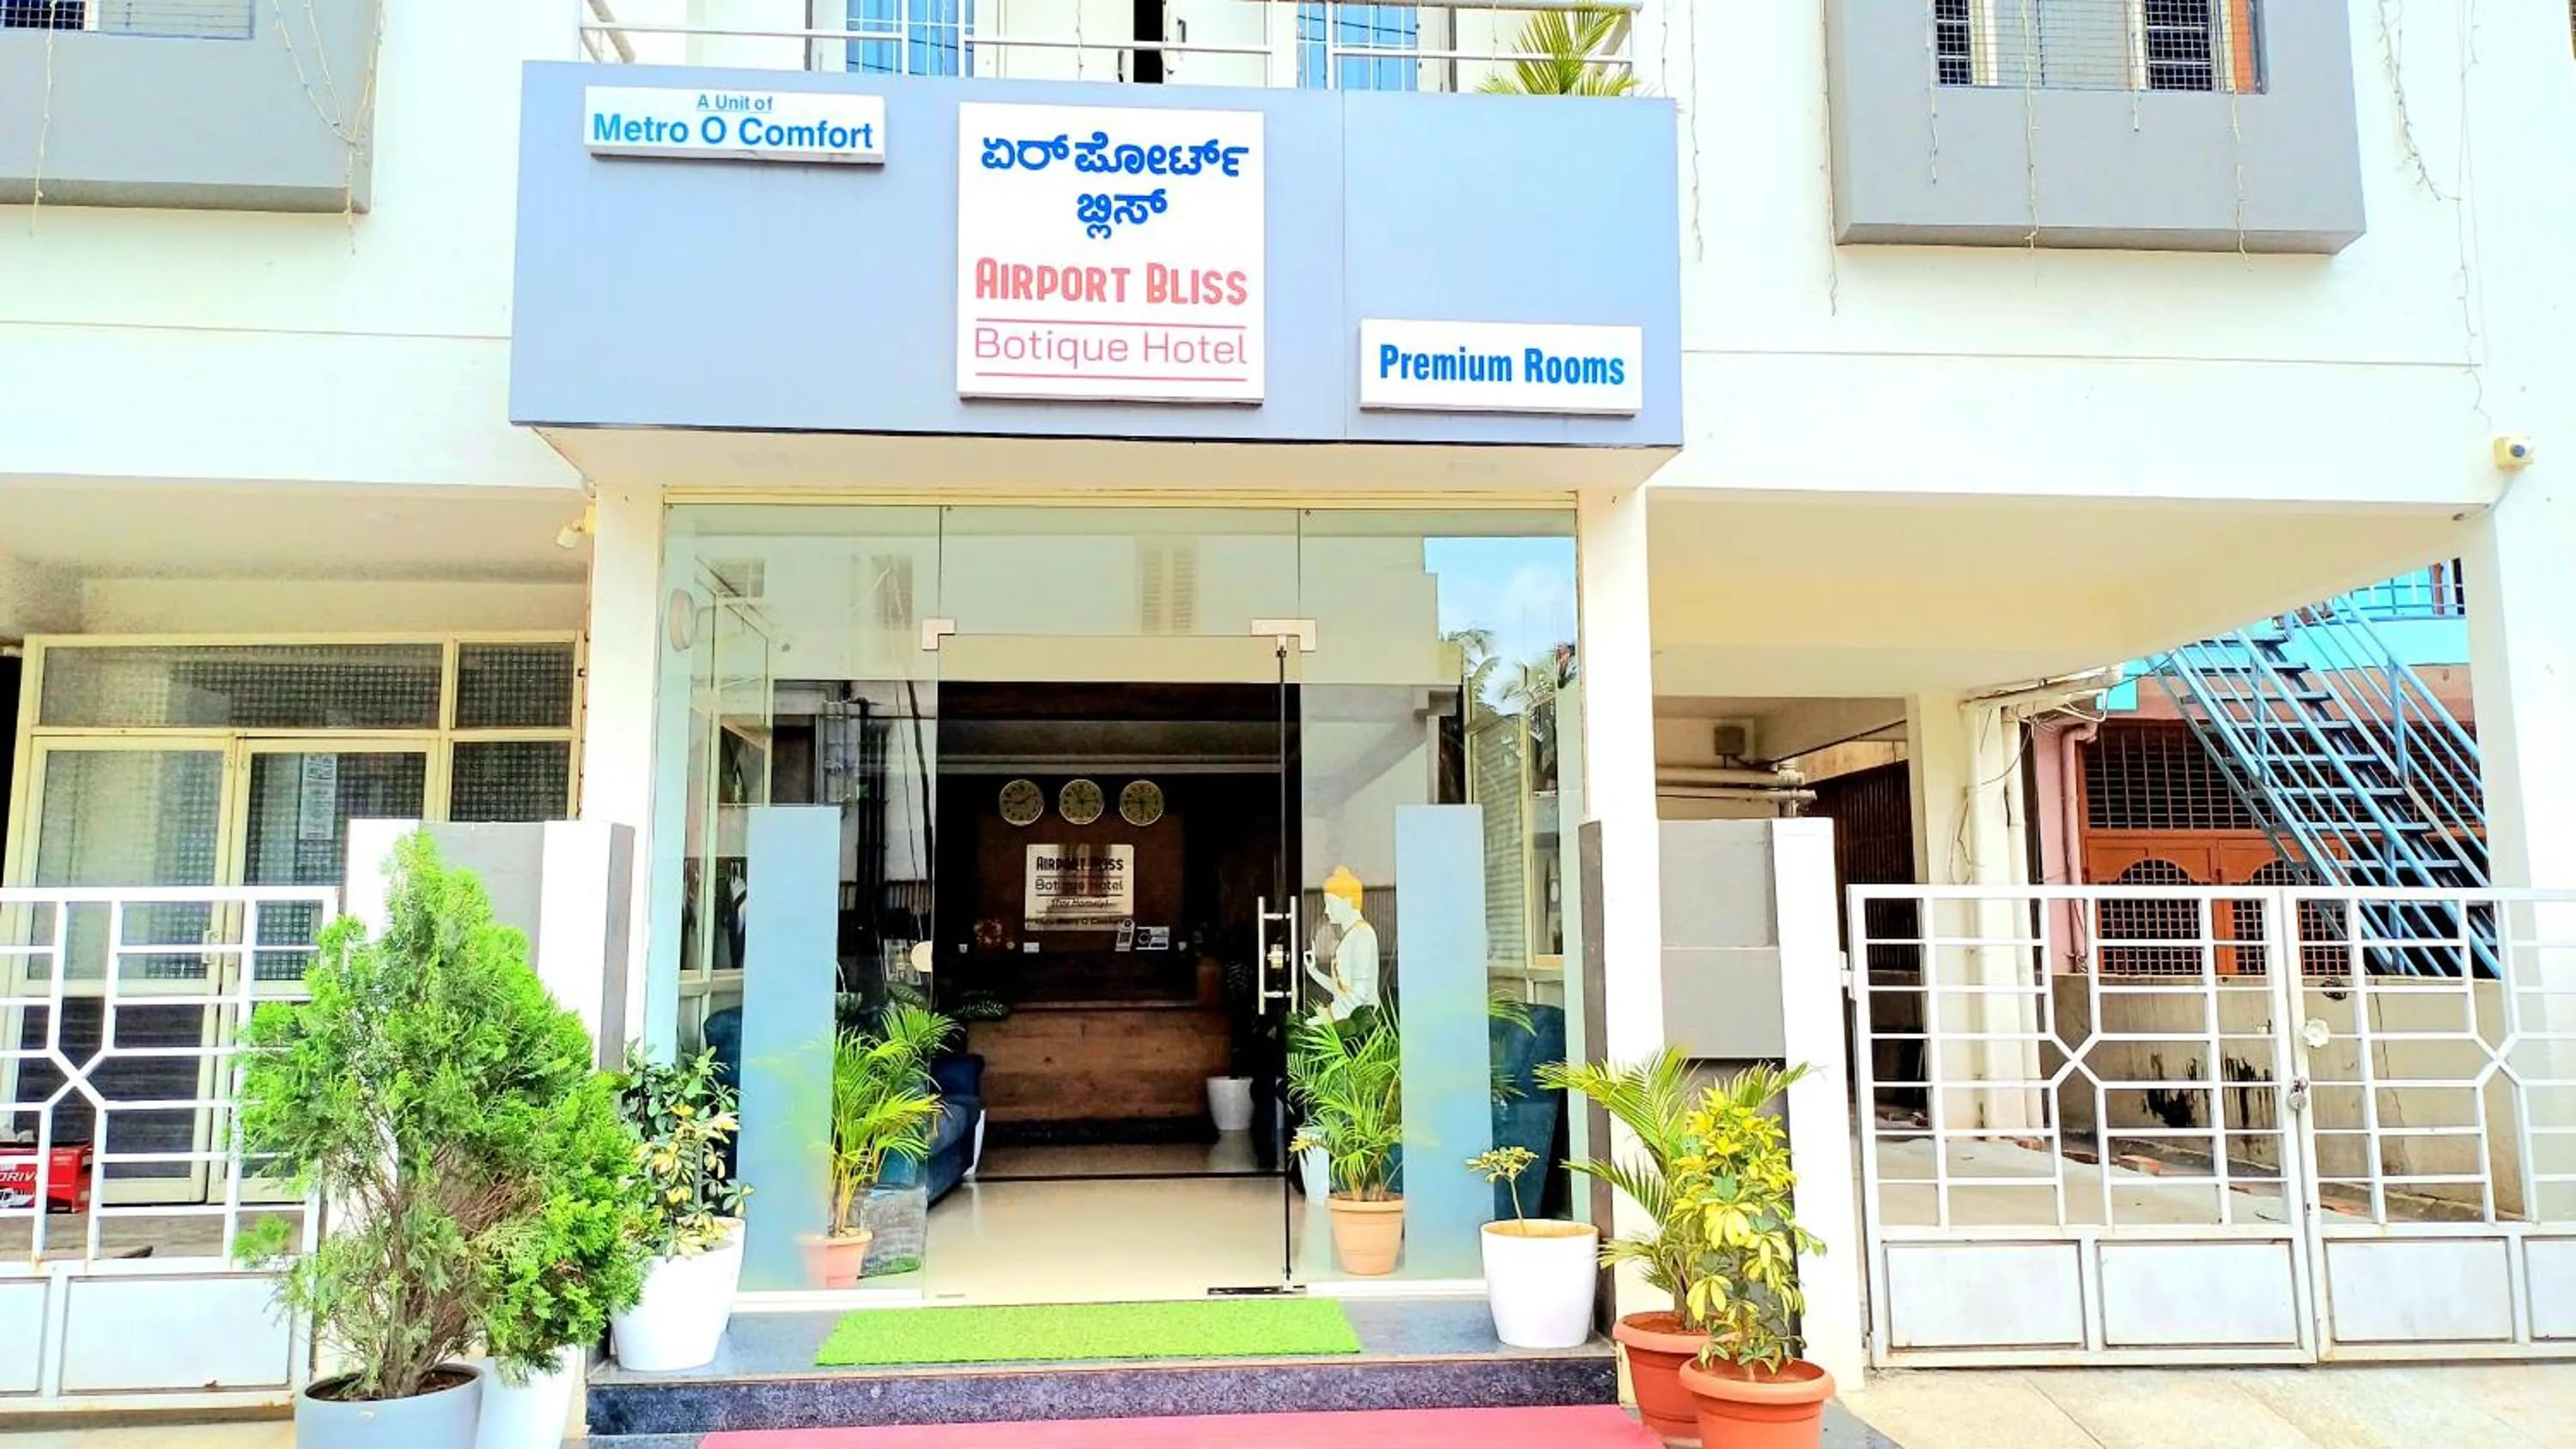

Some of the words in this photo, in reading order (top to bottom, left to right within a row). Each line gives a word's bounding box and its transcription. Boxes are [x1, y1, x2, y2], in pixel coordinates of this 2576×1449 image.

[697, 94, 710, 110] A
[715, 94, 750, 111] Unit
[754, 96, 774, 112] of
[592, 112, 690, 143] Metro
[701, 116, 726, 146] O
[738, 117, 873, 149] Comfort
[975, 257, 1131, 303] AIRPORT
[1146, 262, 1248, 306] BLISS
[975, 327, 1129, 369] Botique
[1144, 330, 1248, 365] Hotel
[1380, 343, 1513, 382] Premium
[1524, 347, 1625, 385] Rooms
